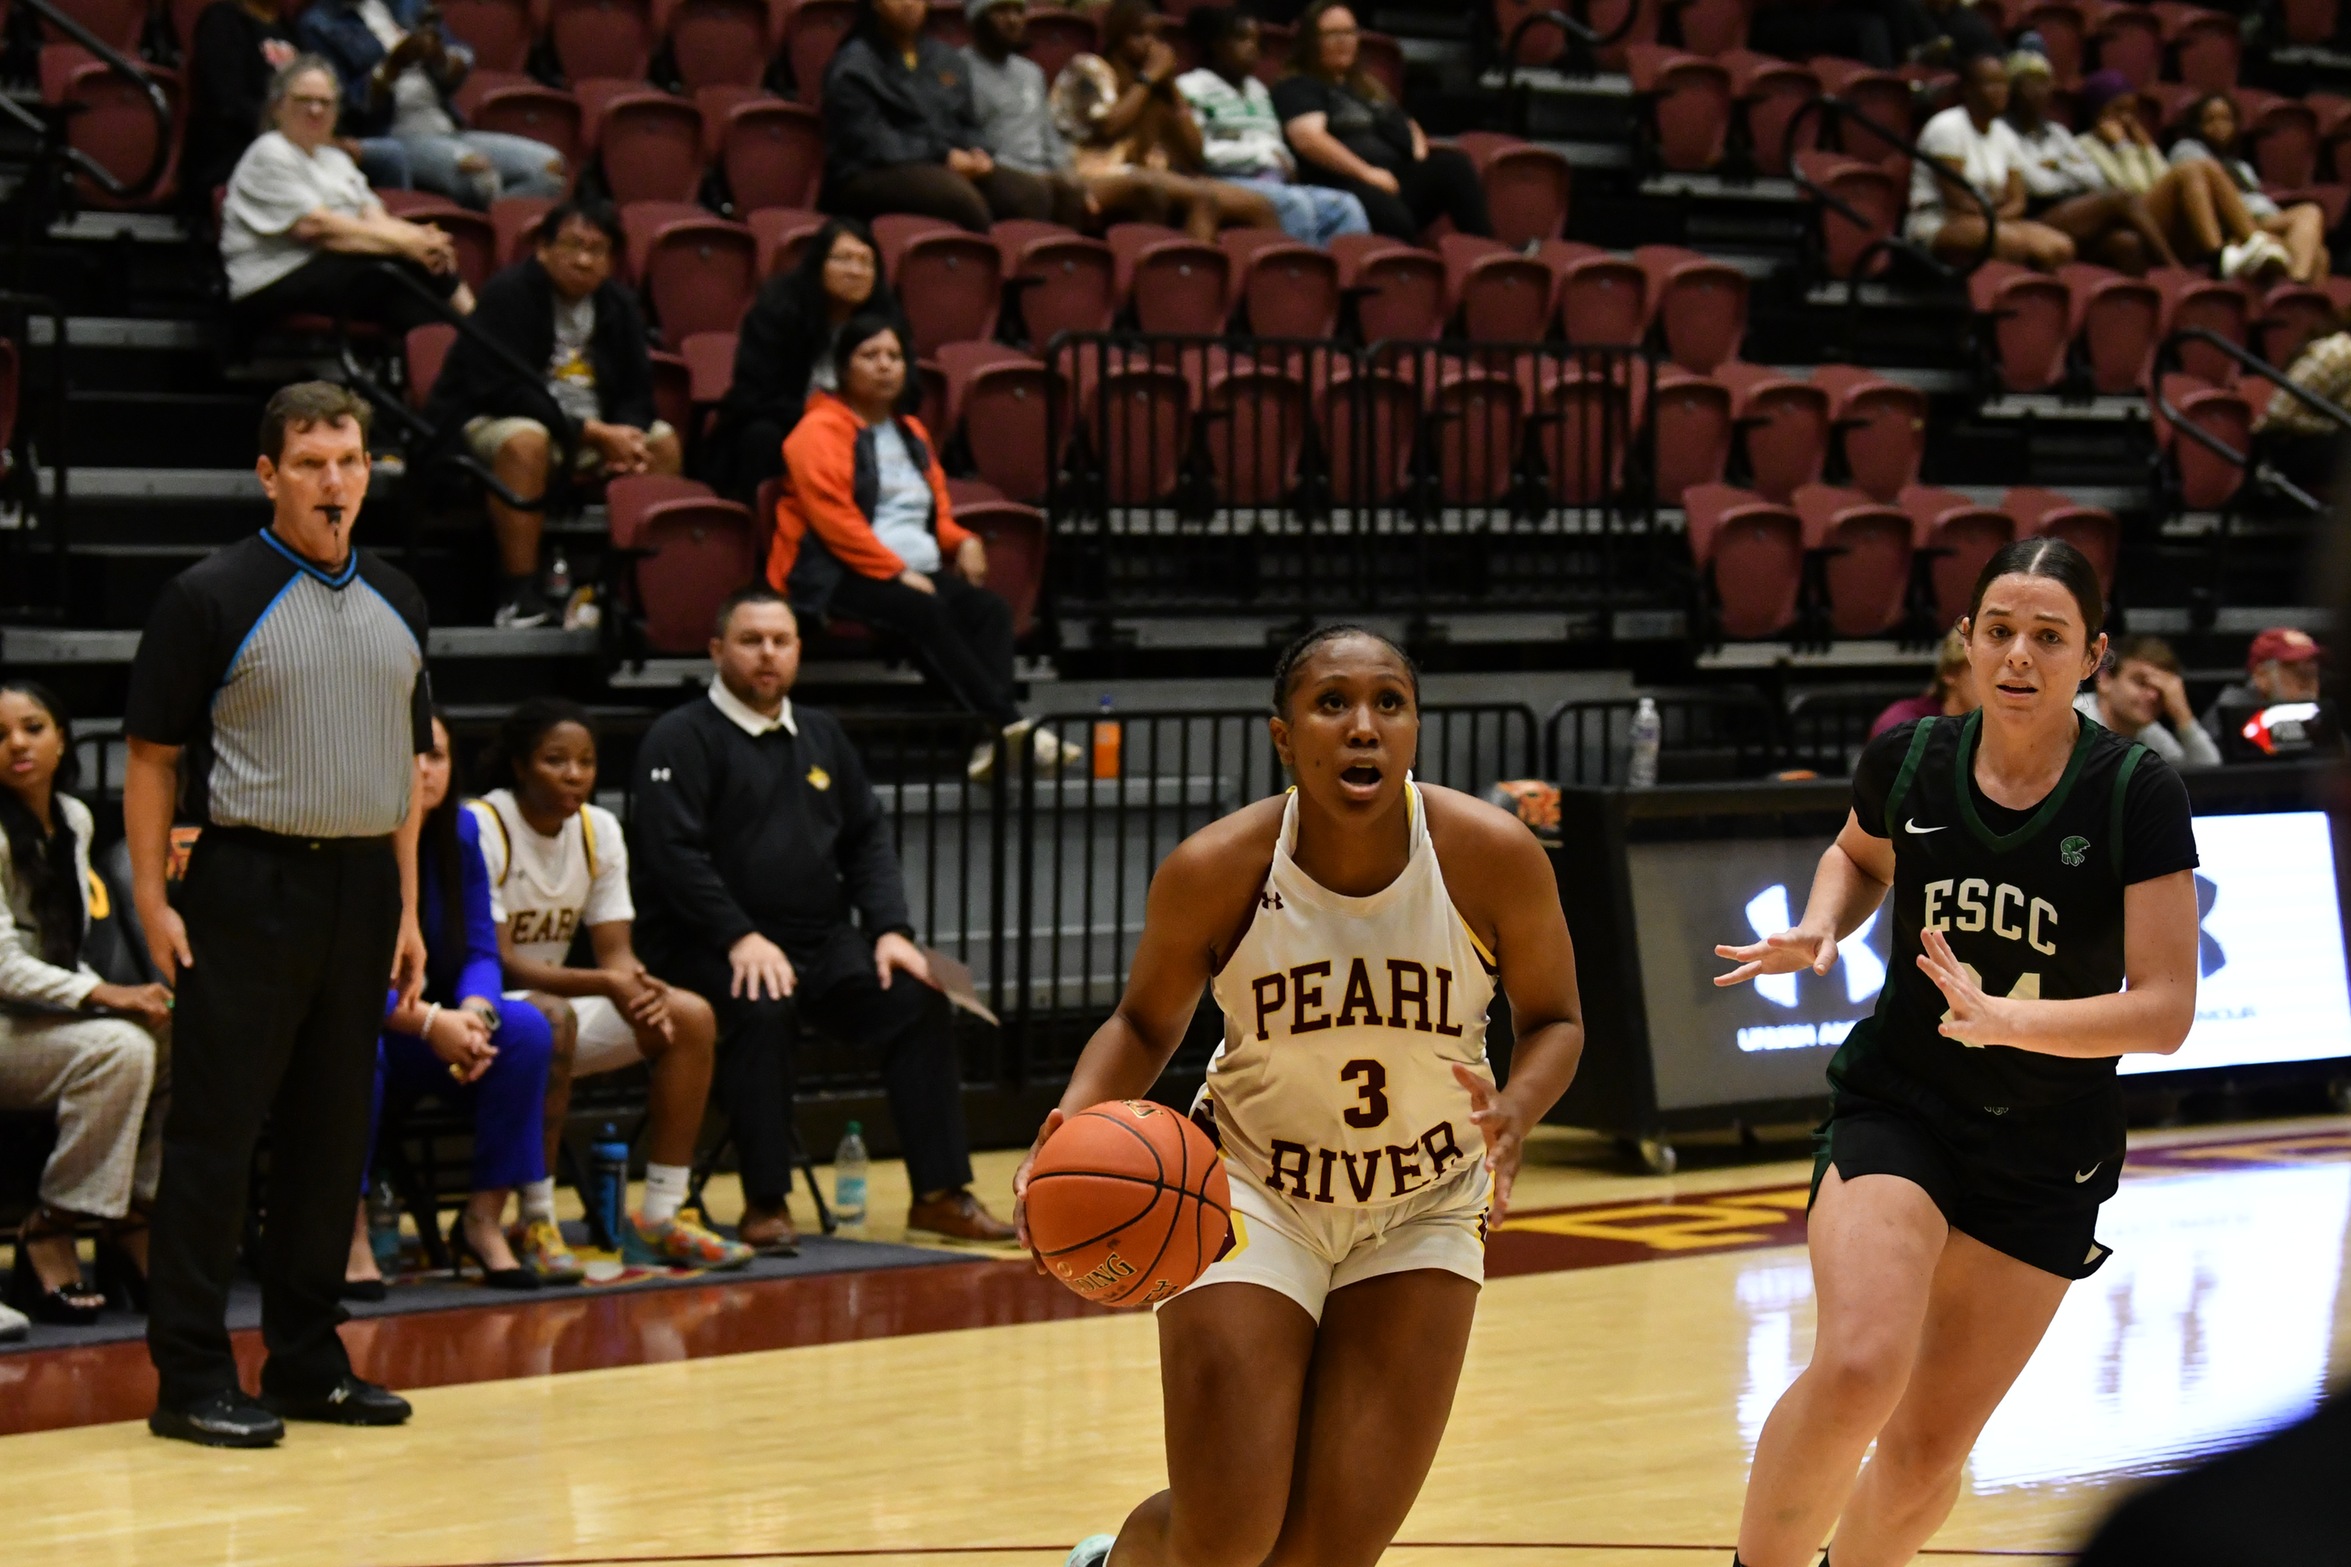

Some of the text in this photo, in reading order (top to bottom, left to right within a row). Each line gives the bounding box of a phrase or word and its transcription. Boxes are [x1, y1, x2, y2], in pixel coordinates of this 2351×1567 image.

[1924, 877, 2058, 956] ESCC
[1251, 957, 1464, 1042] PEARL
[1339, 1058, 1390, 1129] 3
[1264, 1120, 1465, 1203] RIVER
